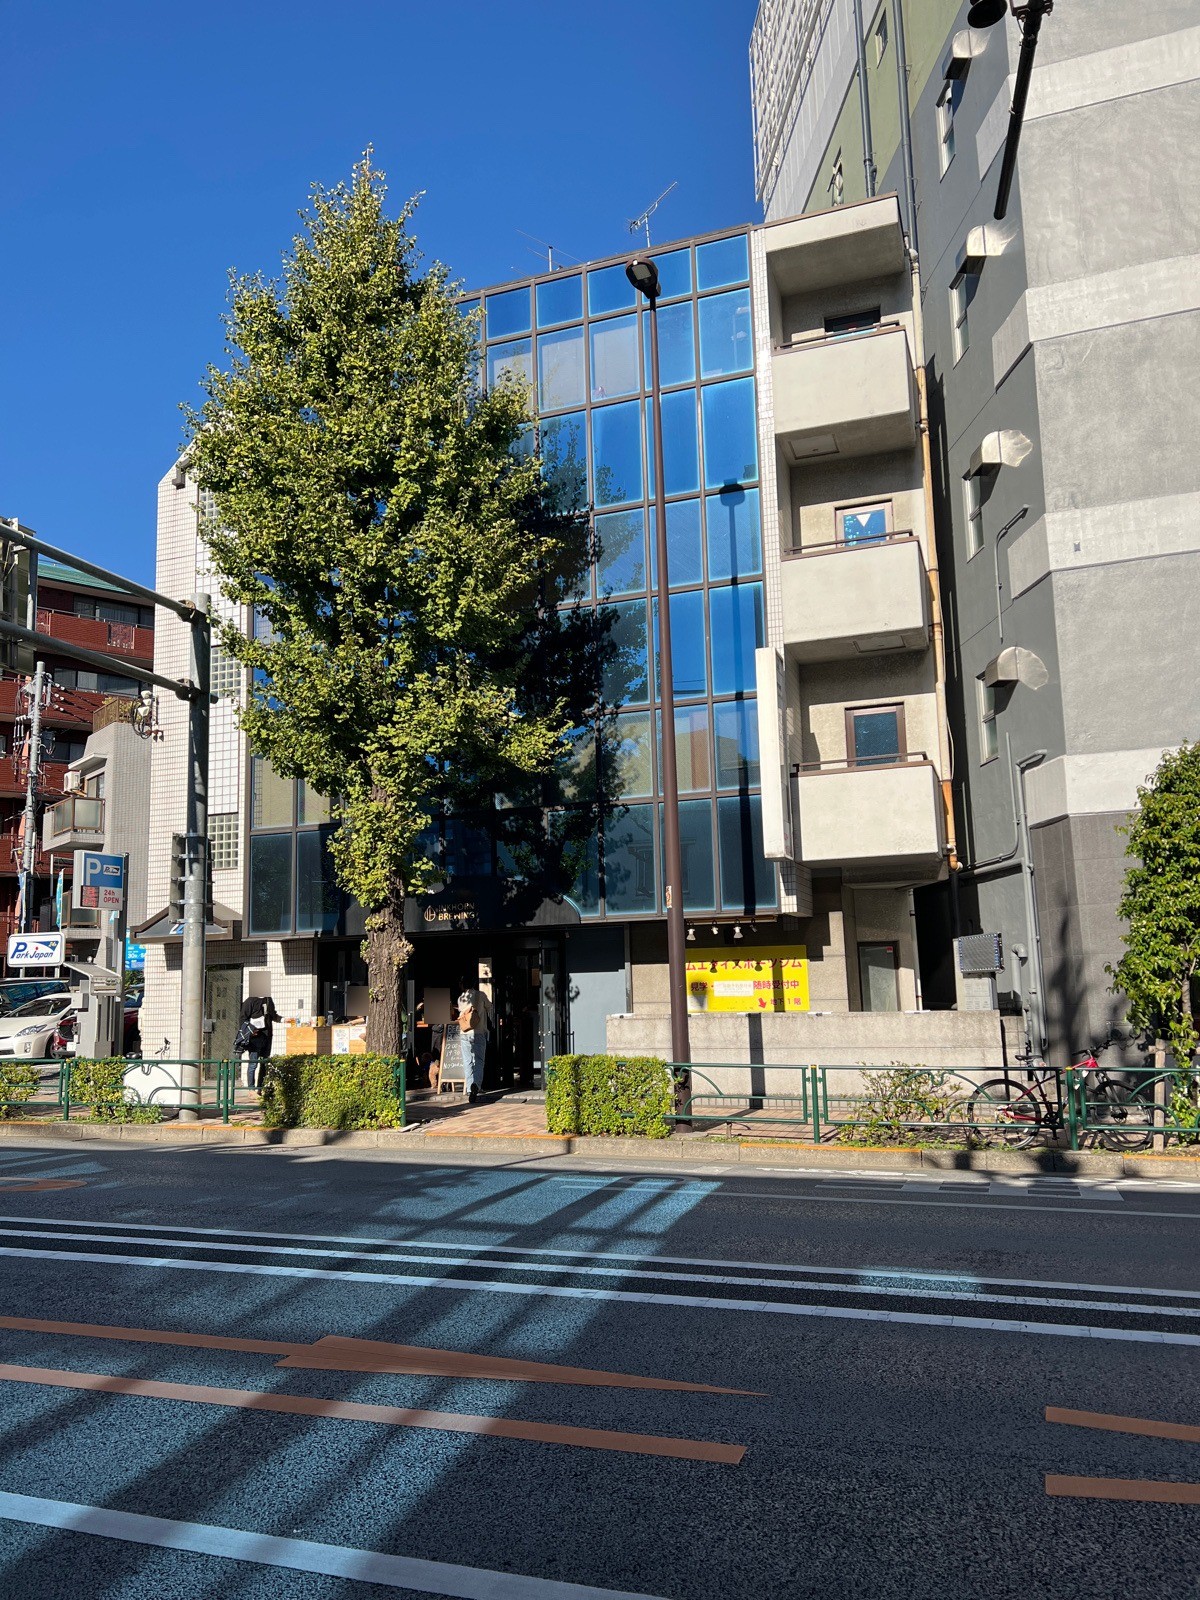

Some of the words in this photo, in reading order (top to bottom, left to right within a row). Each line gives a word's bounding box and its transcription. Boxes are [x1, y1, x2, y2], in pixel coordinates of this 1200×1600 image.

[86, 857, 101, 886] P
[103, 896, 120, 904] OPEN
[438, 902, 475, 911] INKHORN
[438, 911, 475, 921] BREWING
[10, 941, 30, 959] Park
[29, 946, 54, 960] Japan
[753, 980, 799, 990] 随時受付中
